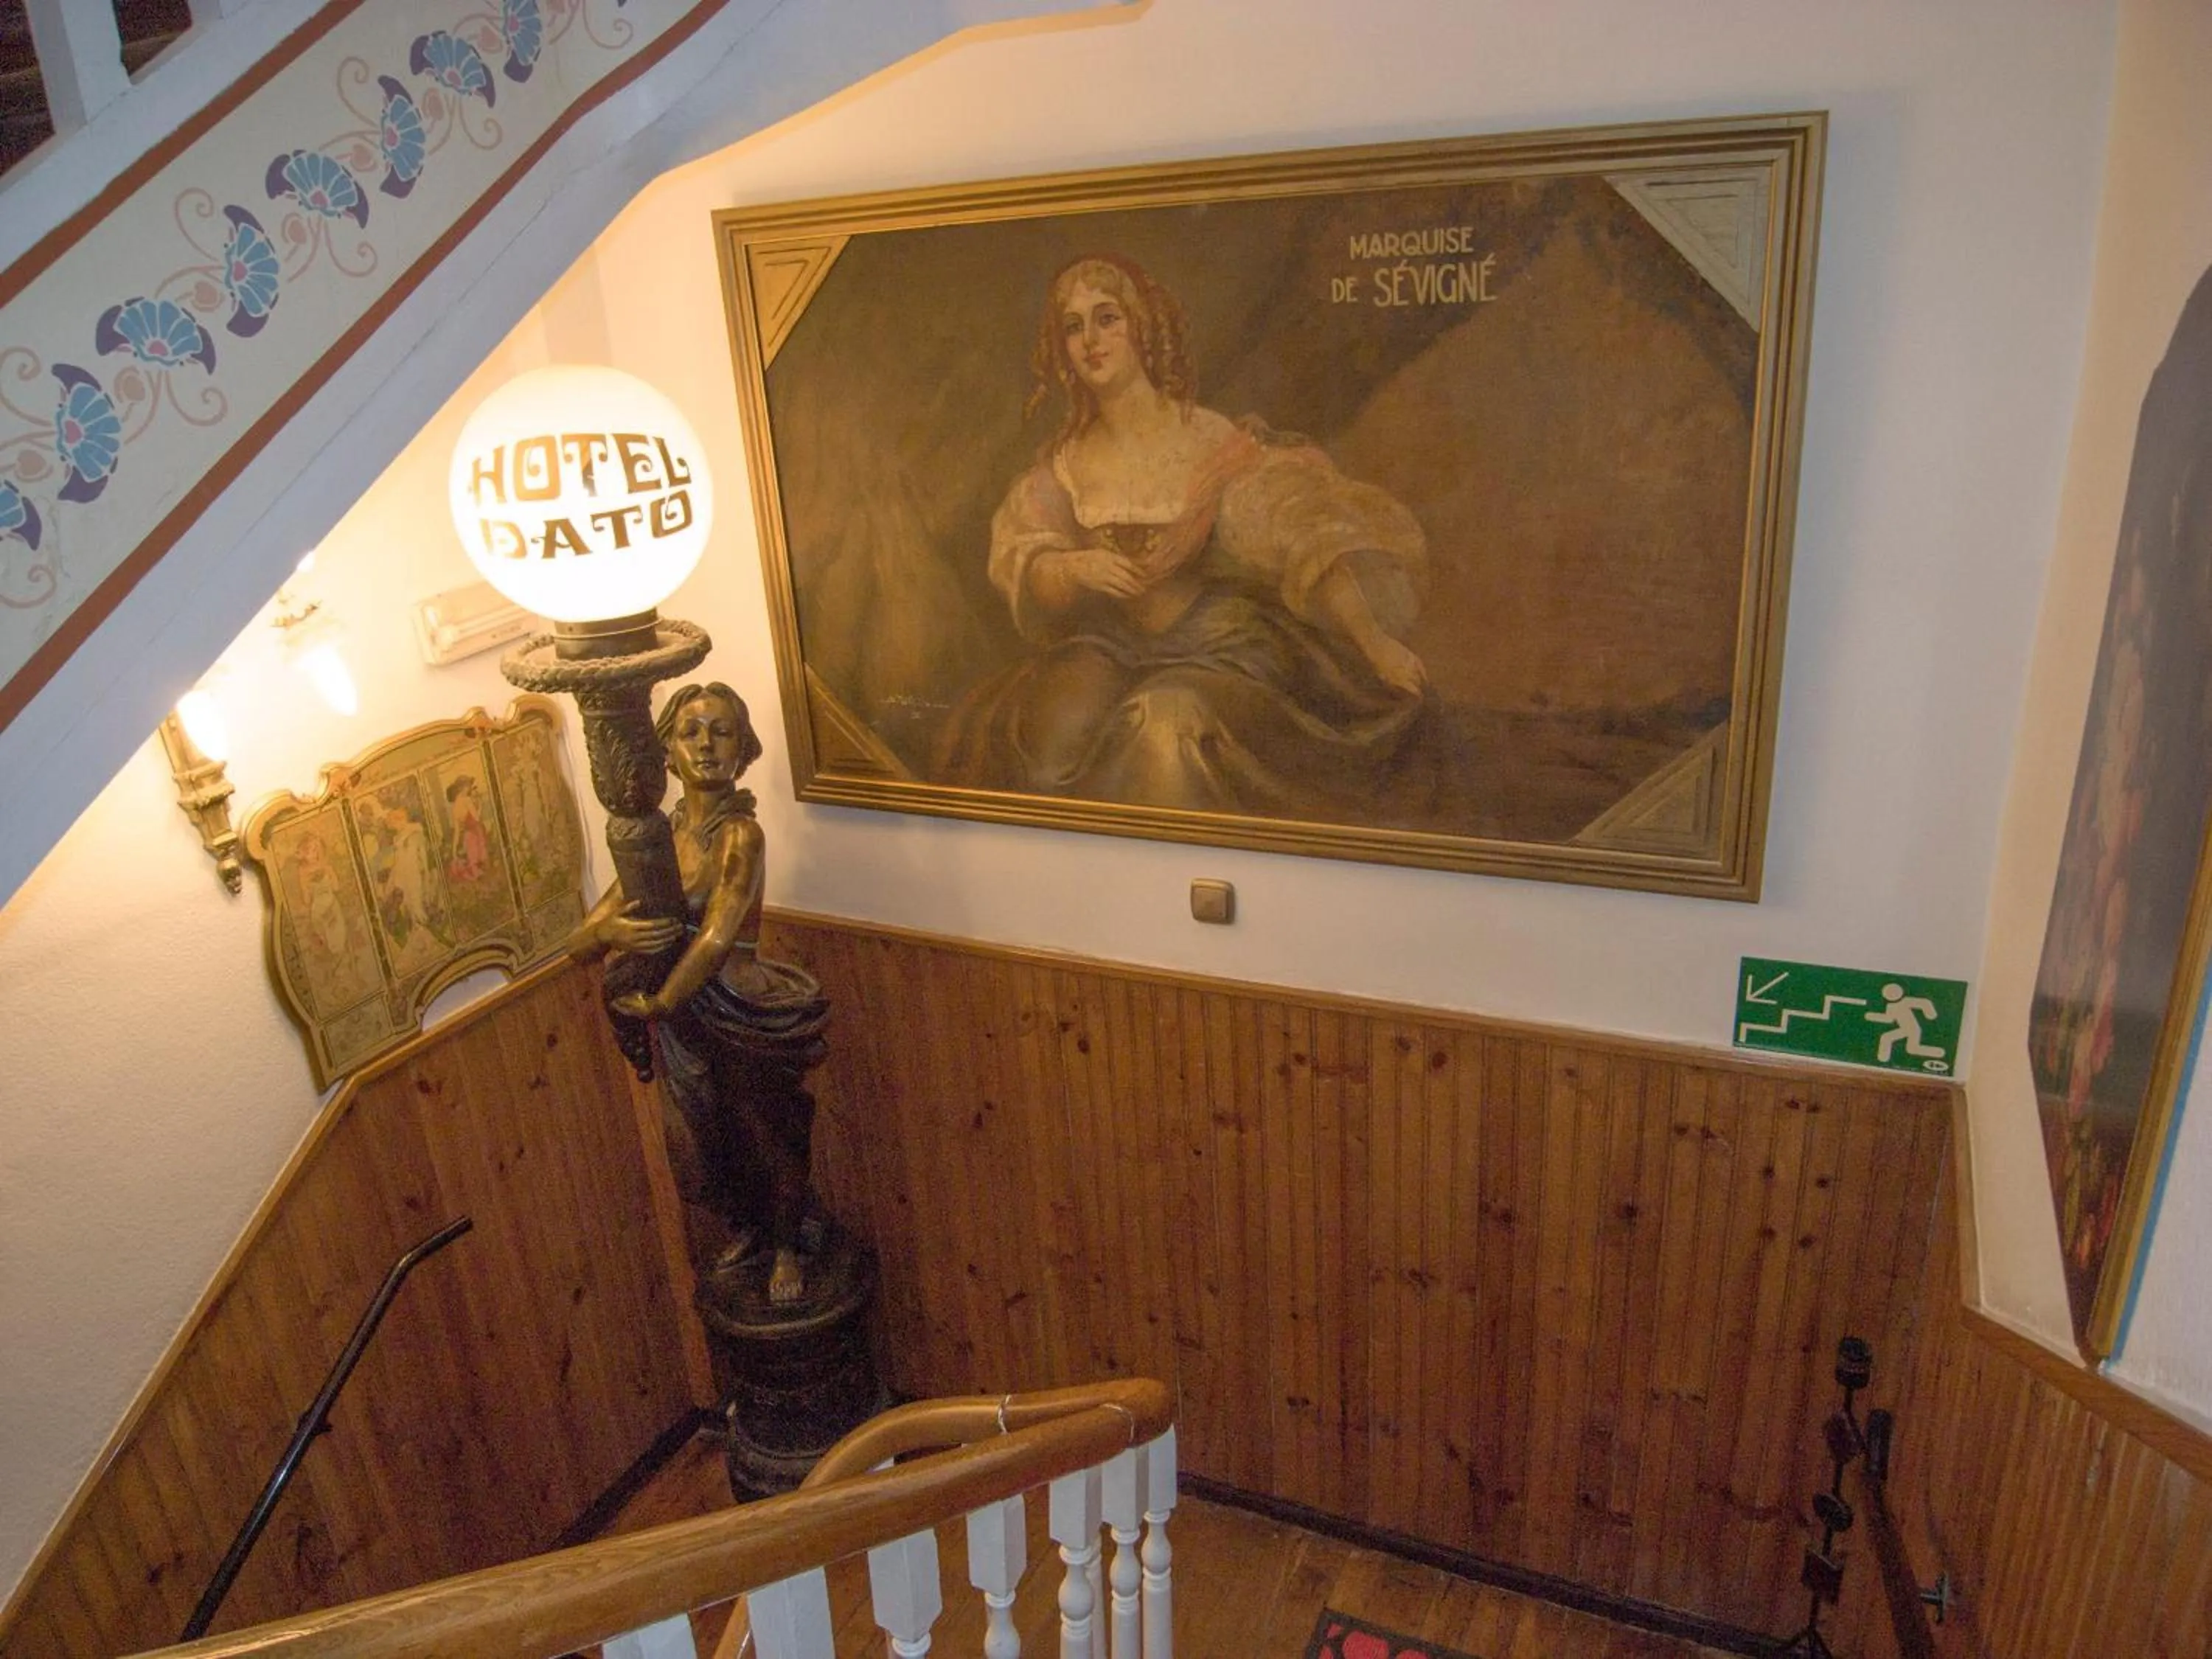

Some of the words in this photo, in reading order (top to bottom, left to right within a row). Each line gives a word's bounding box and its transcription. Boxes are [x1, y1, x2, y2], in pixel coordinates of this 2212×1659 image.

[1349, 226, 1474, 260] MARQUISE
[1332, 277, 1358, 303] DE
[1374, 253, 1498, 307] SÉVIGNÉ
[470, 433, 692, 506] HOTEL
[479, 490, 693, 559] DATO
